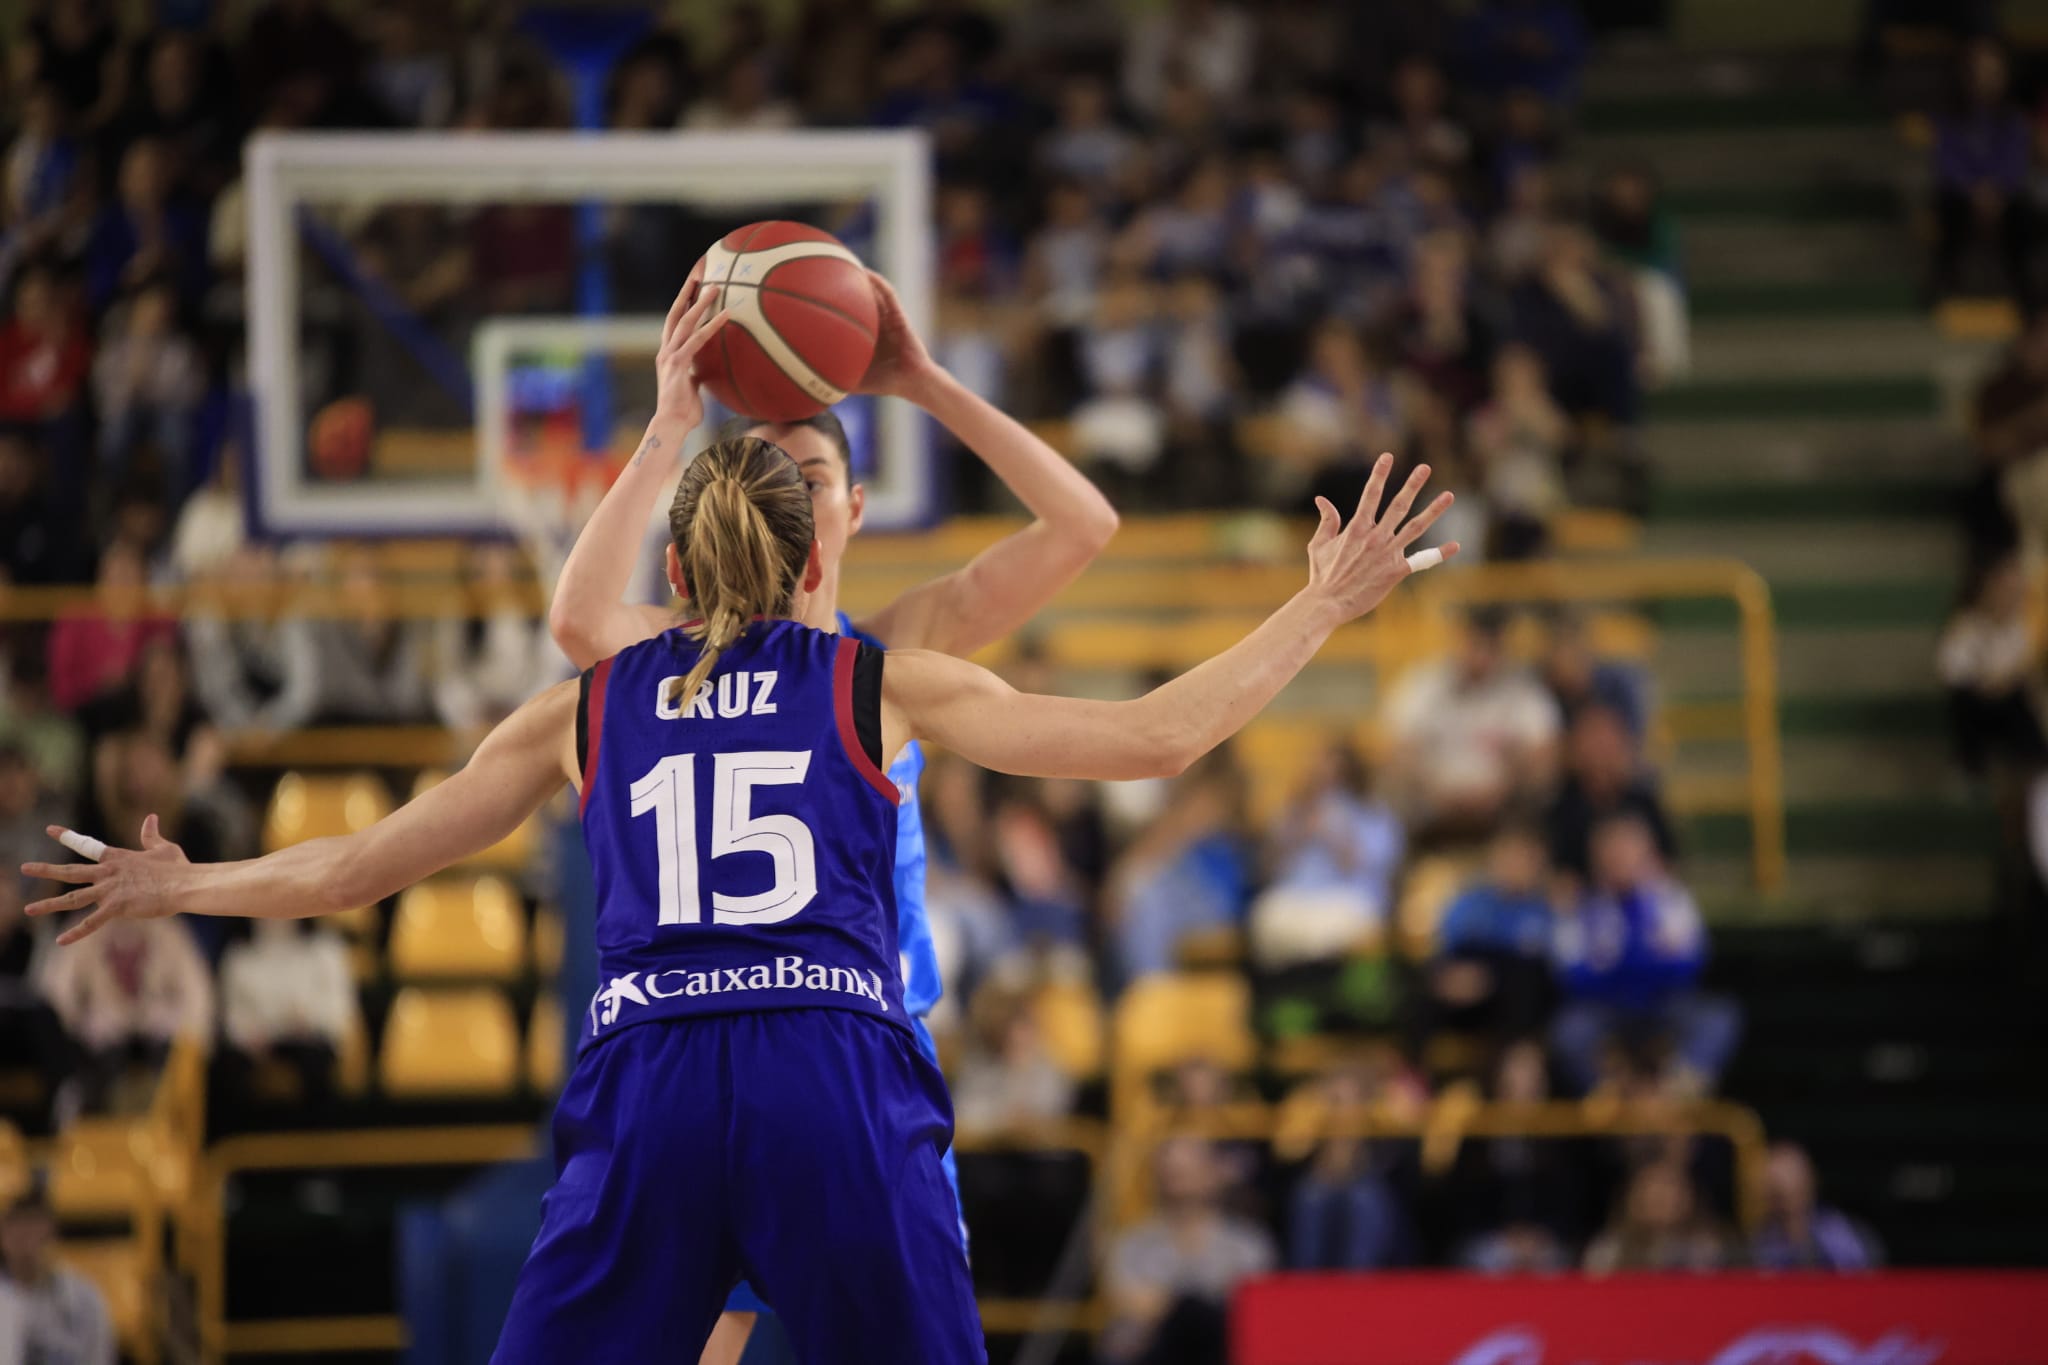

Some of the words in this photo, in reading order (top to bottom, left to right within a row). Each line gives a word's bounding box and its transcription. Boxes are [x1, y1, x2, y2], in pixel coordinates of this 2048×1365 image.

[655, 671, 778, 720] CRUZ
[630, 750, 818, 926] 15
[645, 956, 878, 1001] CaixaBank
